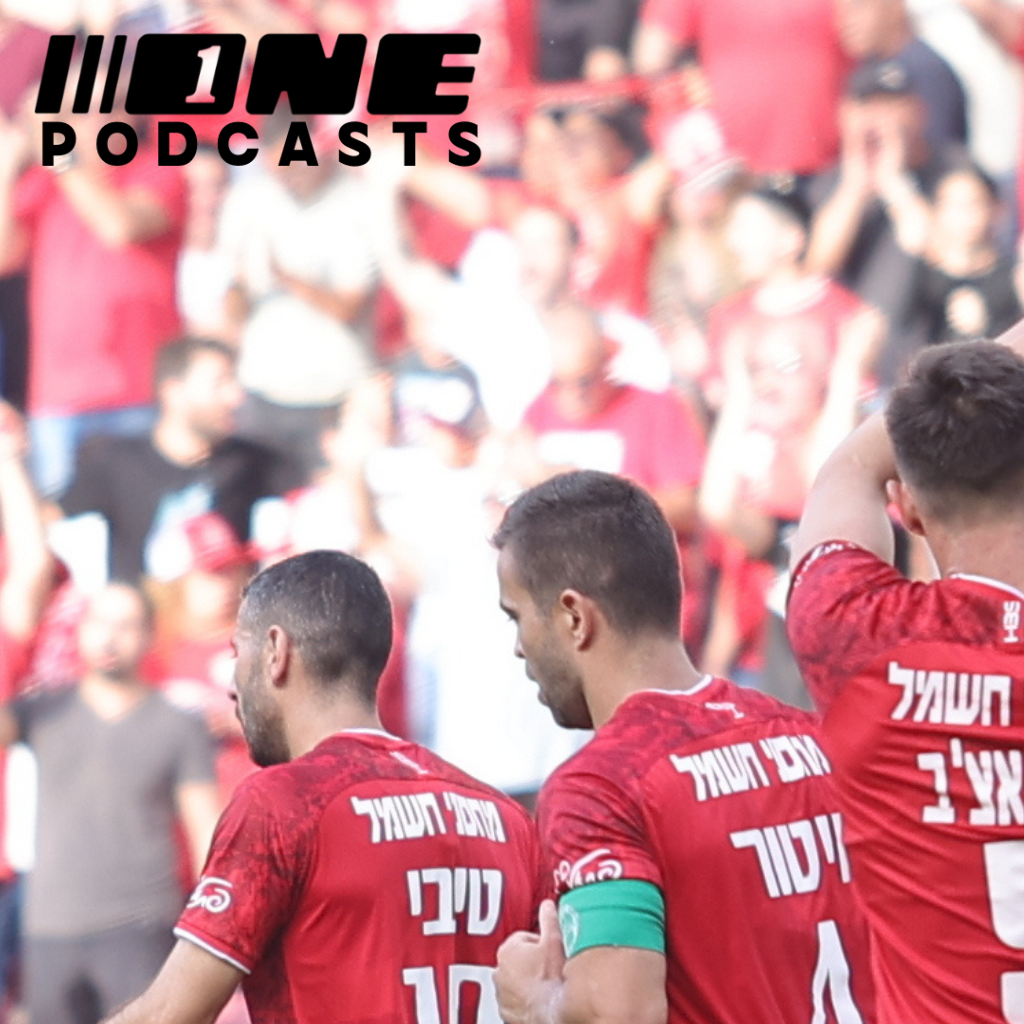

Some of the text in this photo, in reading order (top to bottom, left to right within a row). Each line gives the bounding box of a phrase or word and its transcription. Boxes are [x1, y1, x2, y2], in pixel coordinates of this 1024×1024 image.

[888, 661, 1011, 727] חשמל
[669, 742, 771, 801] חשמל
[350, 791, 507, 843] מחסני חשמל
[406, 867, 504, 937] טיבי
